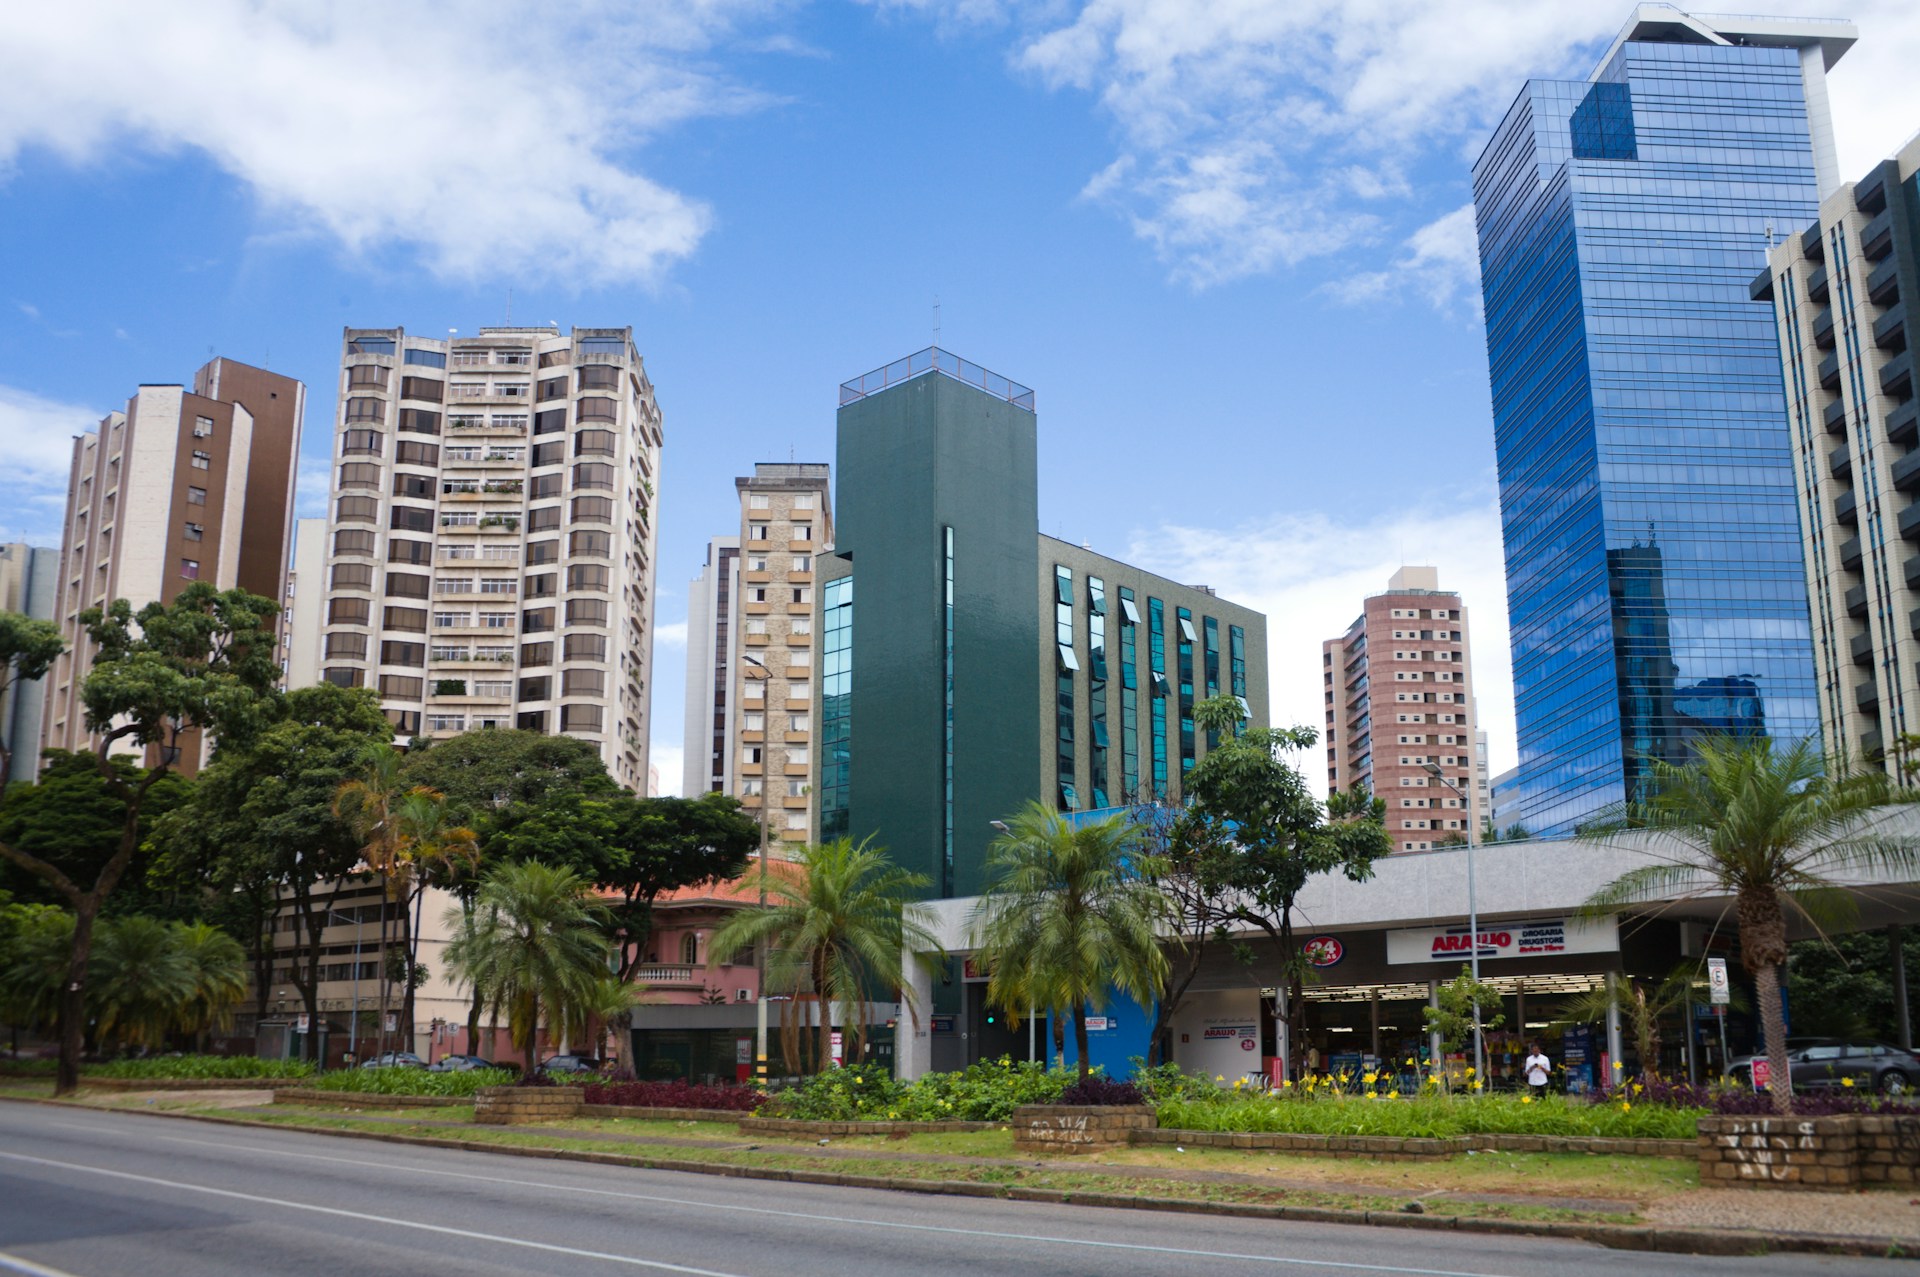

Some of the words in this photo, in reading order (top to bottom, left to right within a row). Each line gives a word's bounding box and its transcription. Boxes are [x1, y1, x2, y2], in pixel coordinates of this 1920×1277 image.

[1522, 928, 1563, 937] DROGARIA
[1432, 932, 1511, 952] ARAUJO
[1518, 937, 1564, 946] DRUGSTORE
[1715, 970, 1721, 983] E
